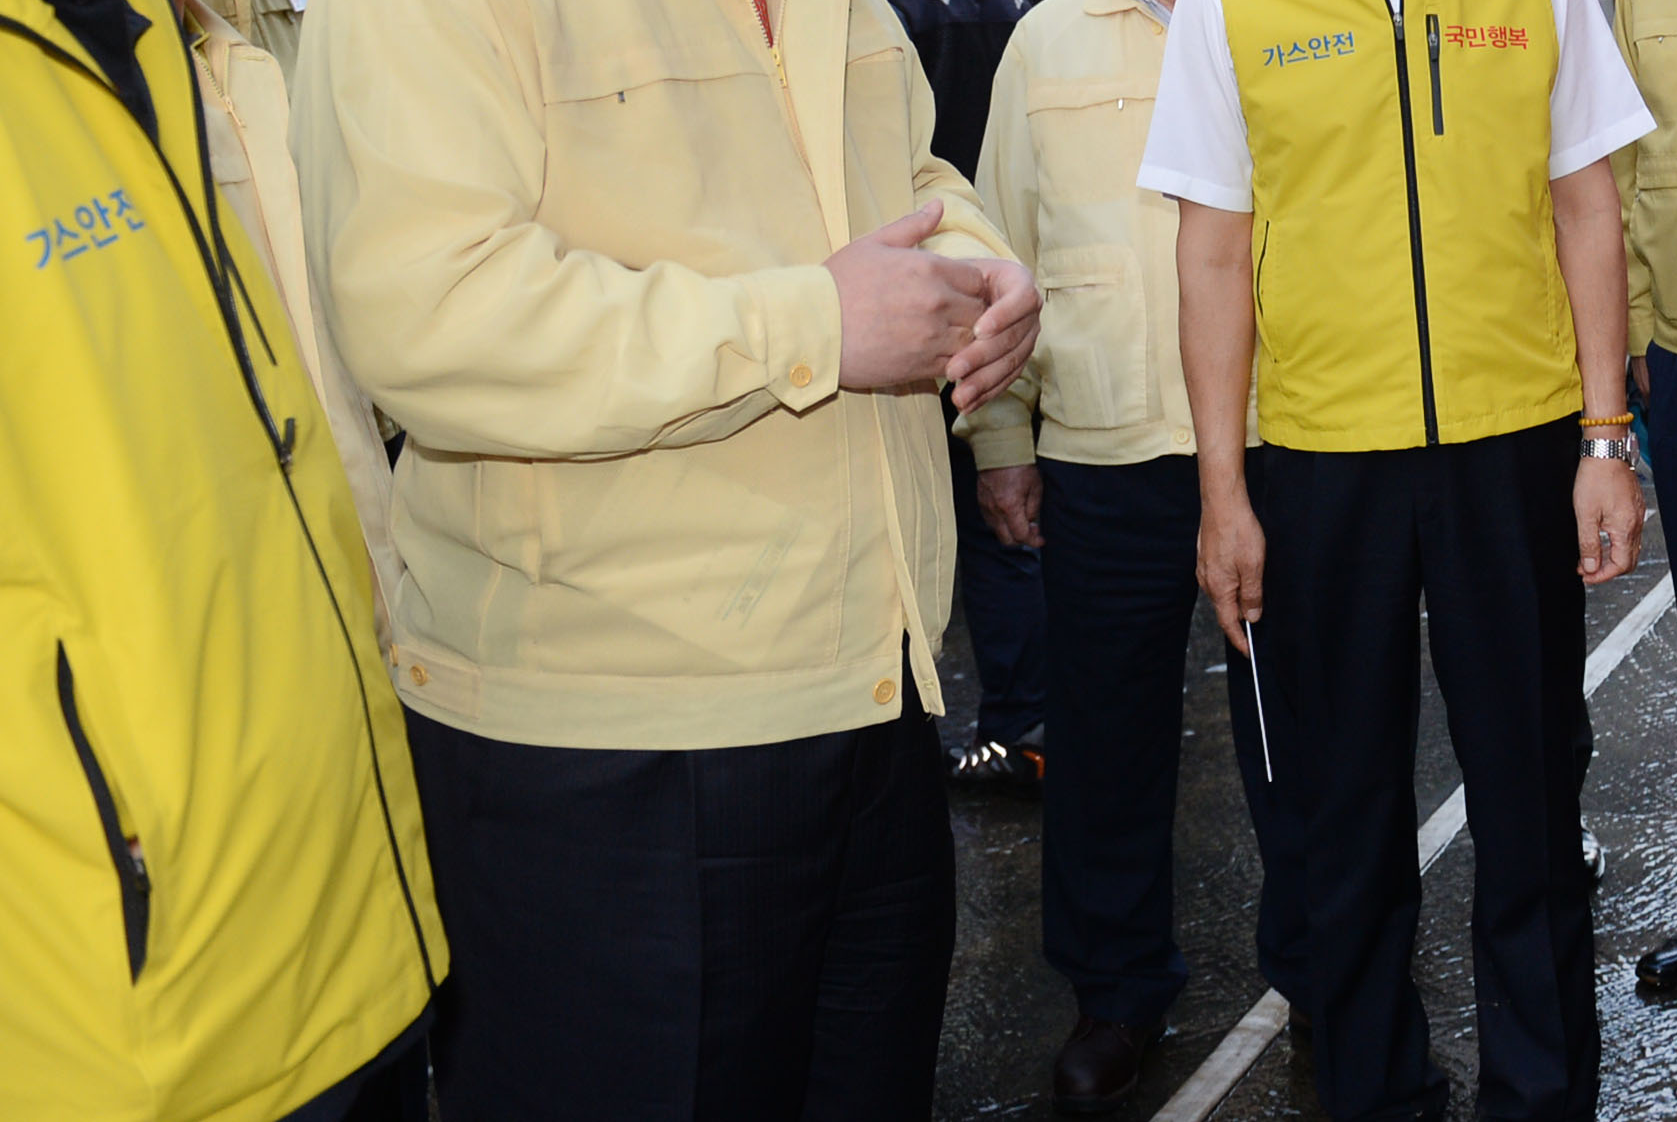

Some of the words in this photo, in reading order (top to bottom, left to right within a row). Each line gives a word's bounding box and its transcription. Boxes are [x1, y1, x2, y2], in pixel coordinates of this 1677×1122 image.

[1262, 31, 1356, 68] 가스안전
[1444, 25, 1530, 50] 국민행복
[25, 188, 146, 269] 가스안전
